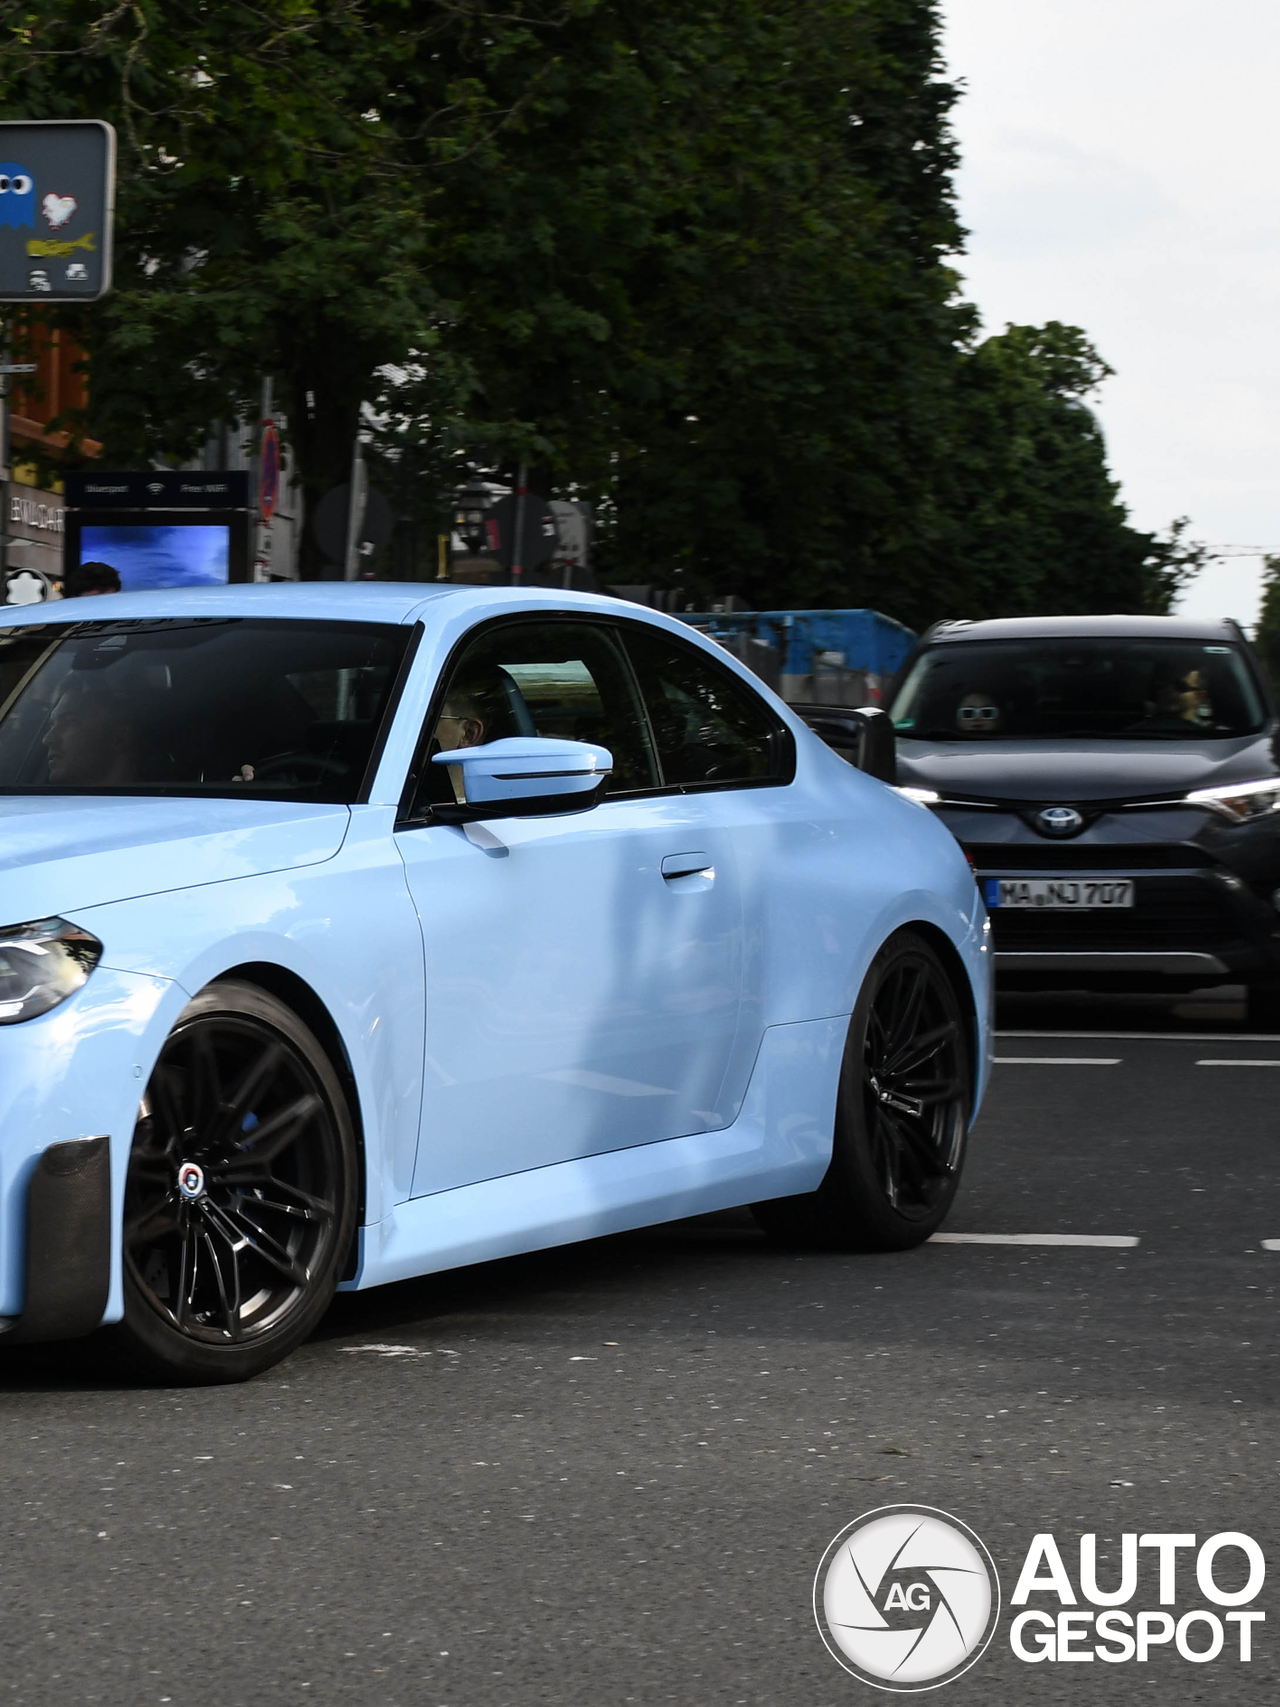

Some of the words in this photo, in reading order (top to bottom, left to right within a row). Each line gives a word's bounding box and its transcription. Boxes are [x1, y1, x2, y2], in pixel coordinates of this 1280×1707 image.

[180, 484, 203, 493] Free
[1048, 883, 1080, 904] NJ
[1084, 883, 1132, 904] 707
